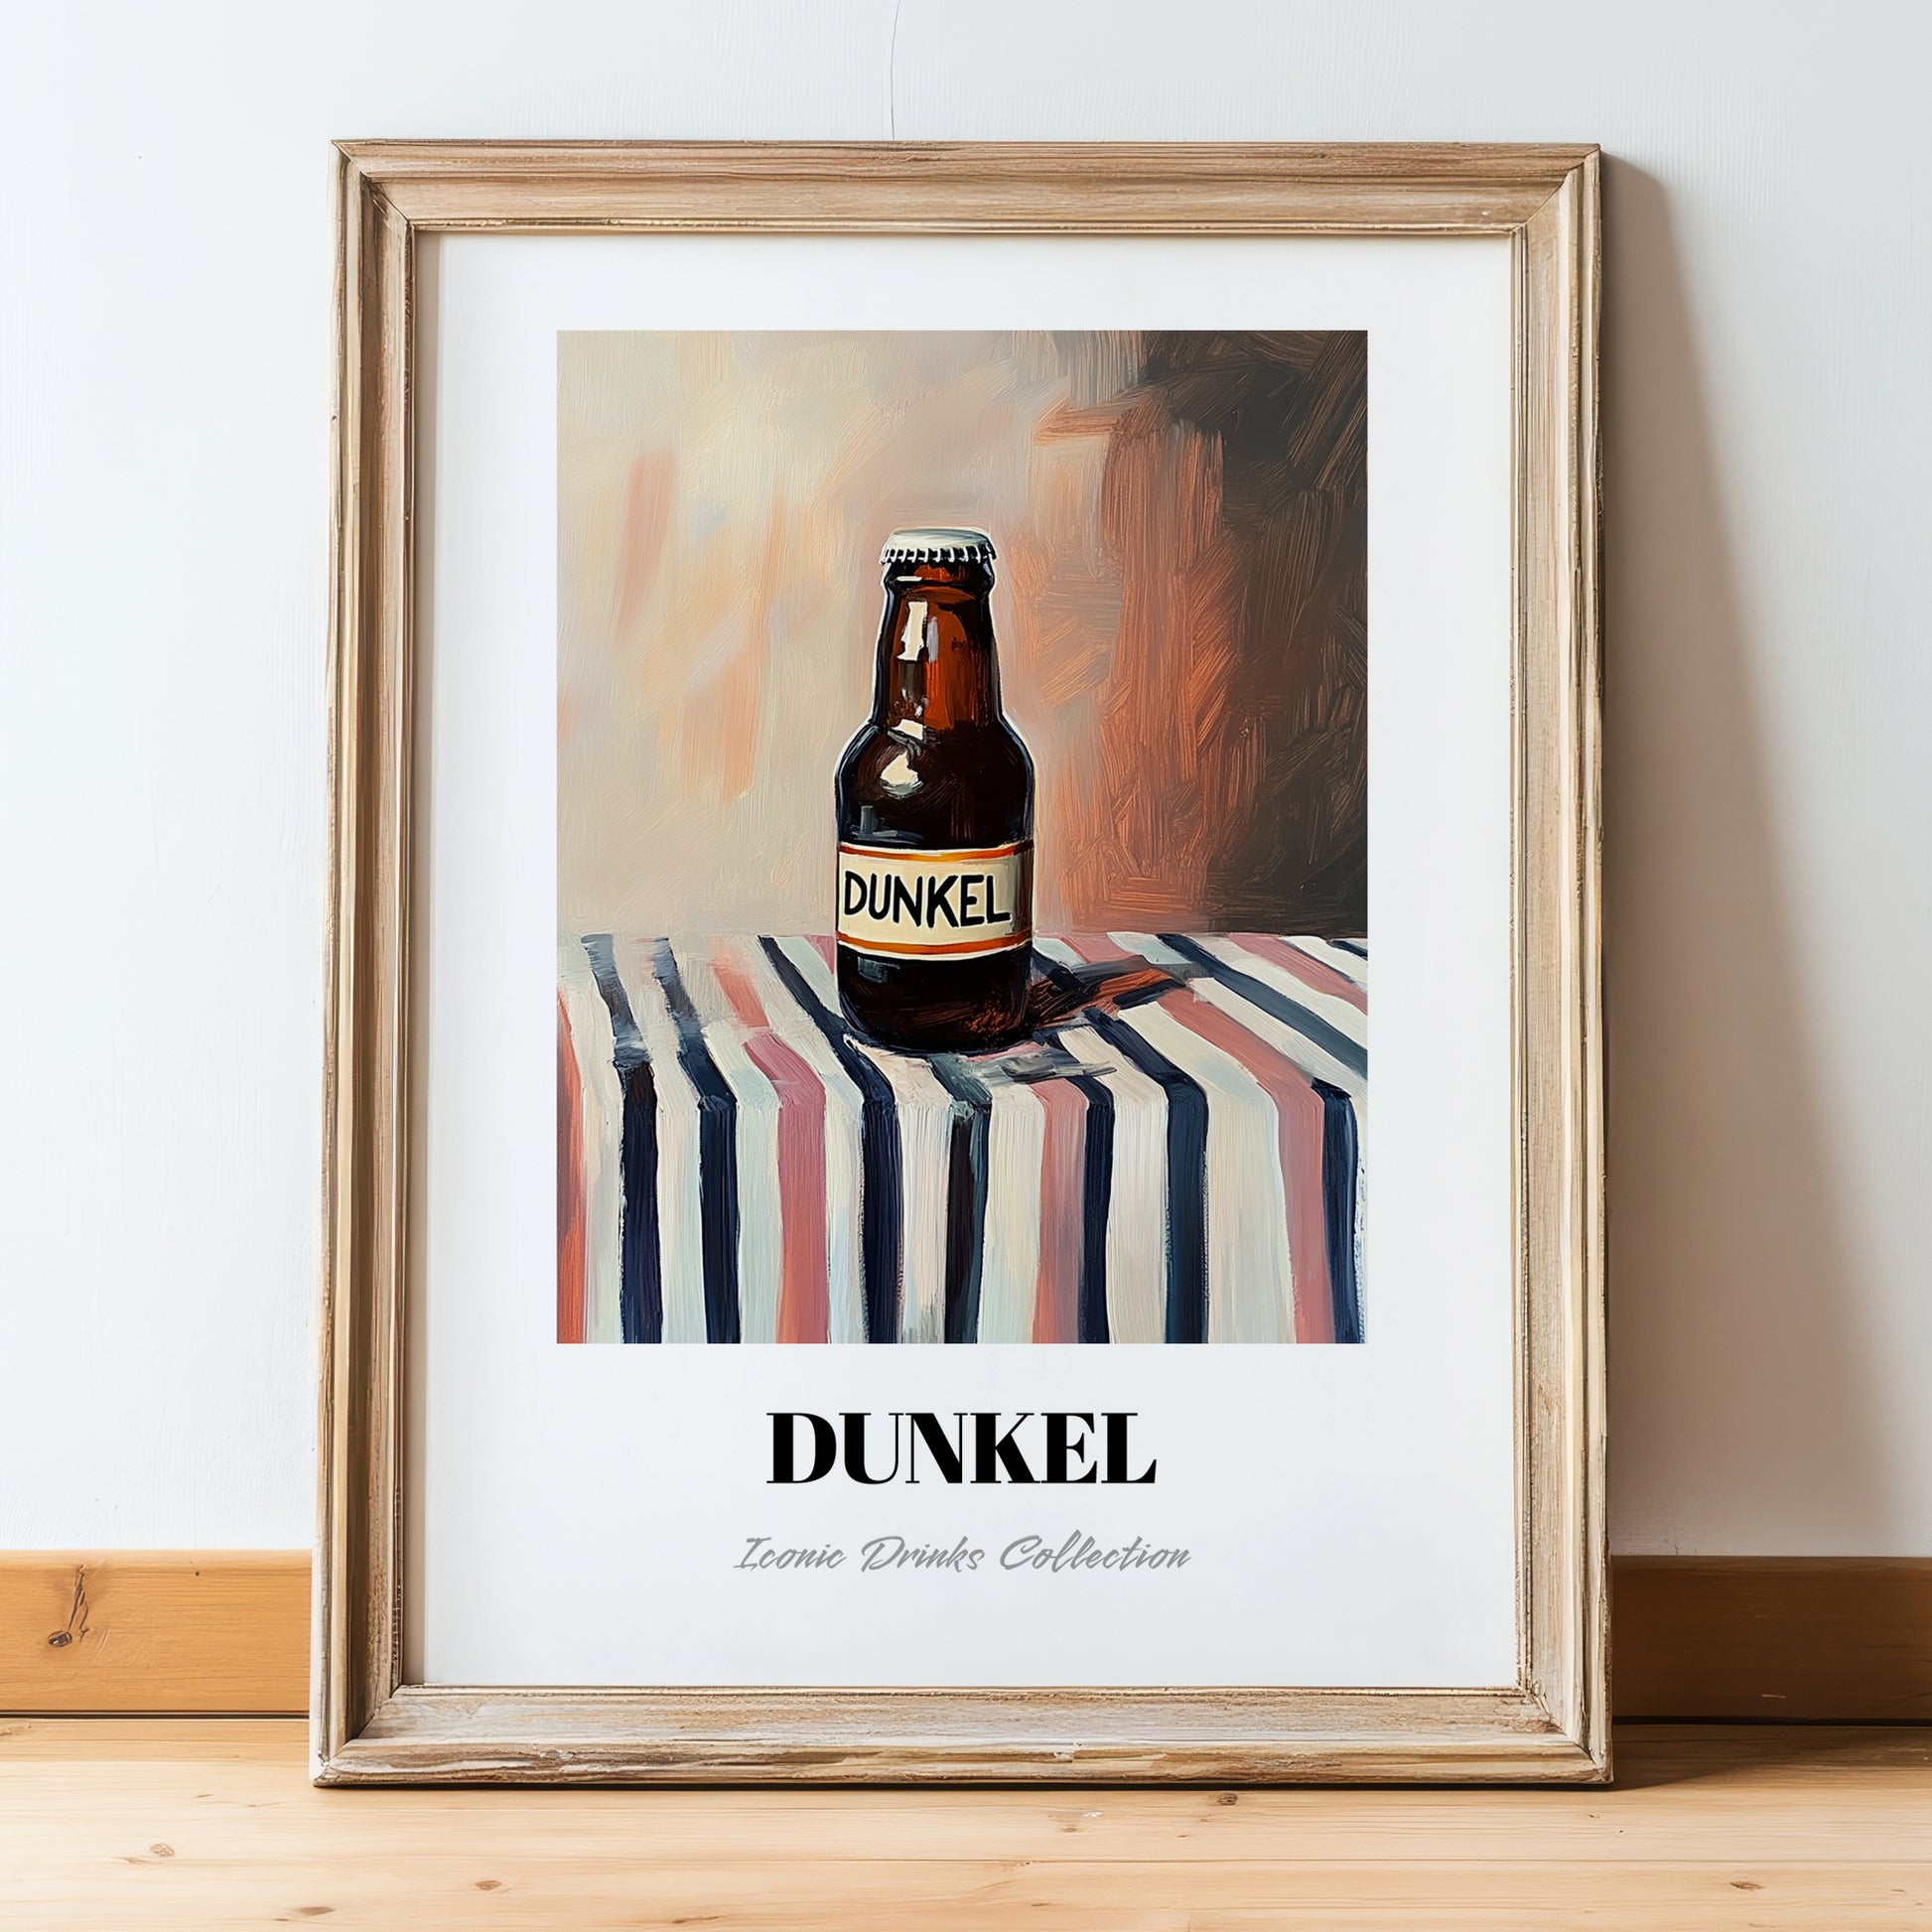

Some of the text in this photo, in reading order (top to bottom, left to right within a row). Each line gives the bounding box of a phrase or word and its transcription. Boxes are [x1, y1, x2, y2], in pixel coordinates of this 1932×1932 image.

[844, 870, 1011, 928] DUNKEL
[765, 1412, 1157, 1485] DUNKEL
[733, 1529, 1192, 1574] Iconic Drinks Collection
